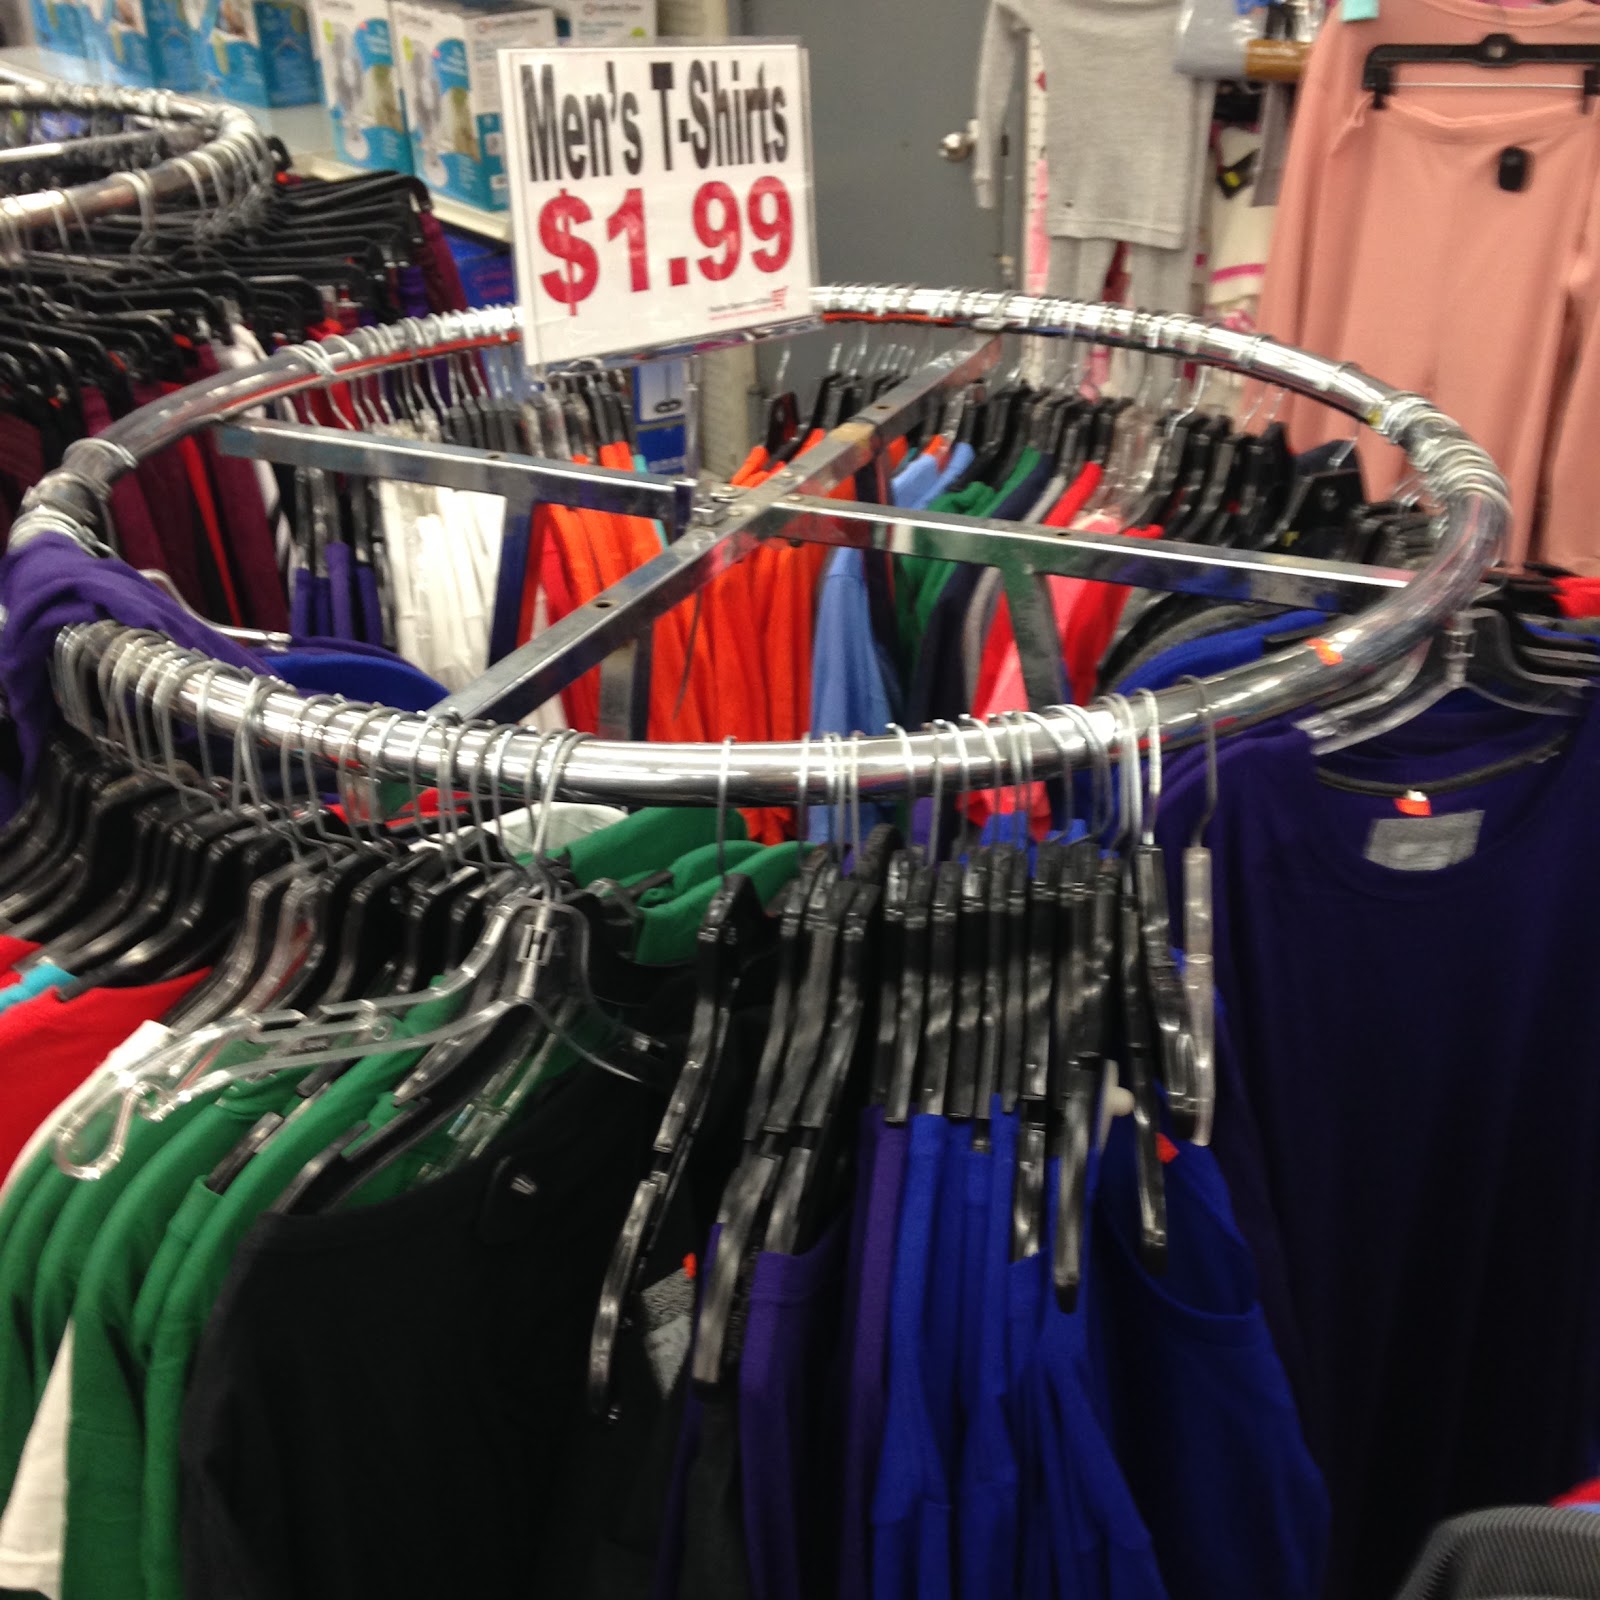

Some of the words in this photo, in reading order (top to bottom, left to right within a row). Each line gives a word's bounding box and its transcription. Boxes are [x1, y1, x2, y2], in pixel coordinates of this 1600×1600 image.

[520, 61, 643, 181] Men's
[650, 60, 789, 171] T-Shirts
[538, 175, 793, 316] $1.99
